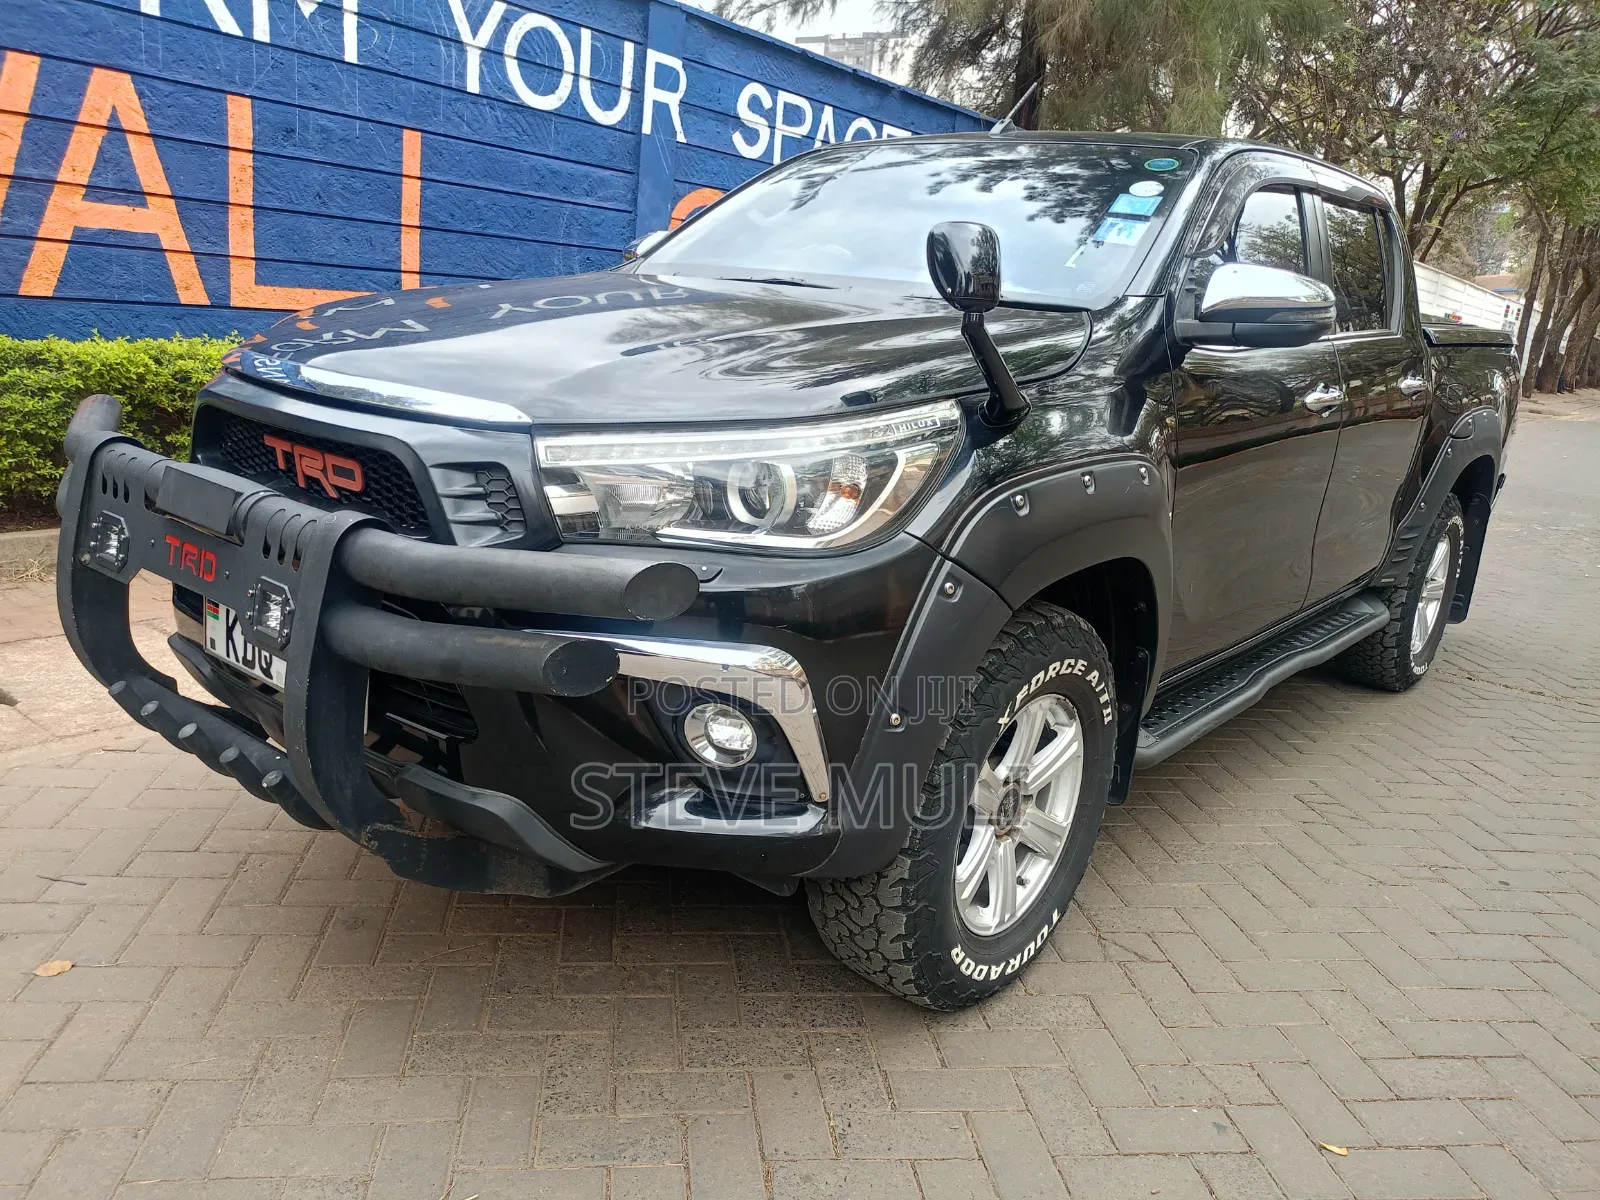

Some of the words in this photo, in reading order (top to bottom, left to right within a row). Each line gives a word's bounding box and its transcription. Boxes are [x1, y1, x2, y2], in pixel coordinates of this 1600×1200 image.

[448, 0, 687, 144] YOUR
[732, 82, 912, 165] SPA
[898, 419, 934, 431] HILUX
[264, 434, 365, 498] TRD
[165, 535, 217, 582] TRD
[1013, 658, 1088, 713] FORCE
[950, 908, 1061, 981] TOURADOR
